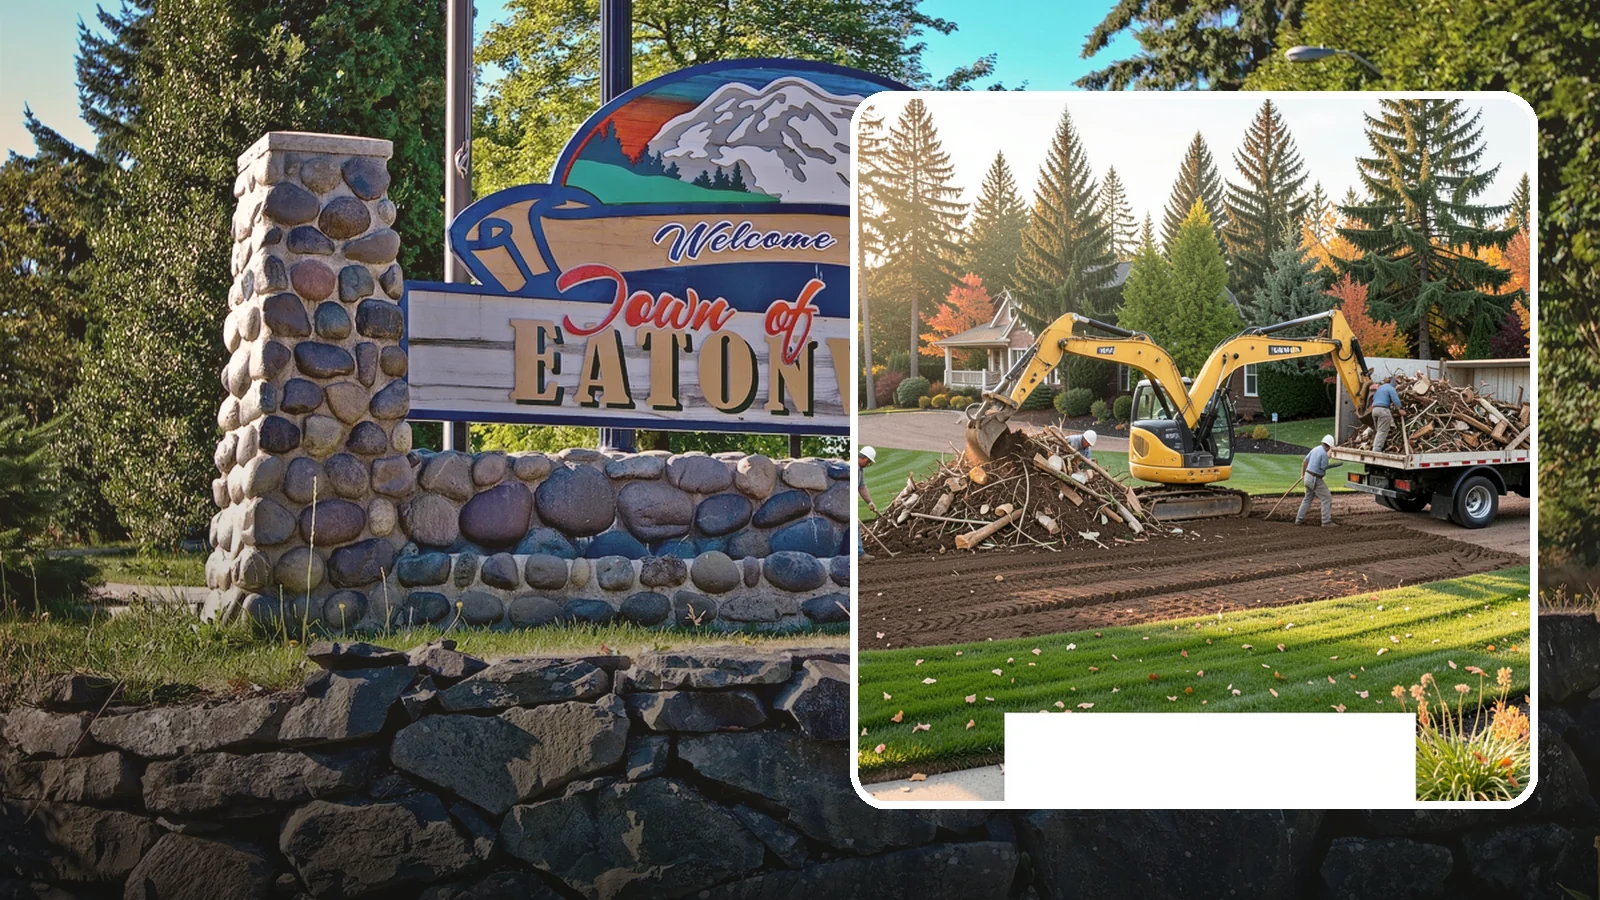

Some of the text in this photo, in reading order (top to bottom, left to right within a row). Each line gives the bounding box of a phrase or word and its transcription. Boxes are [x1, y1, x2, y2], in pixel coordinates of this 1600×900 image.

[653, 221, 836, 263] Welcome
[557, 264, 825, 365] Town of
